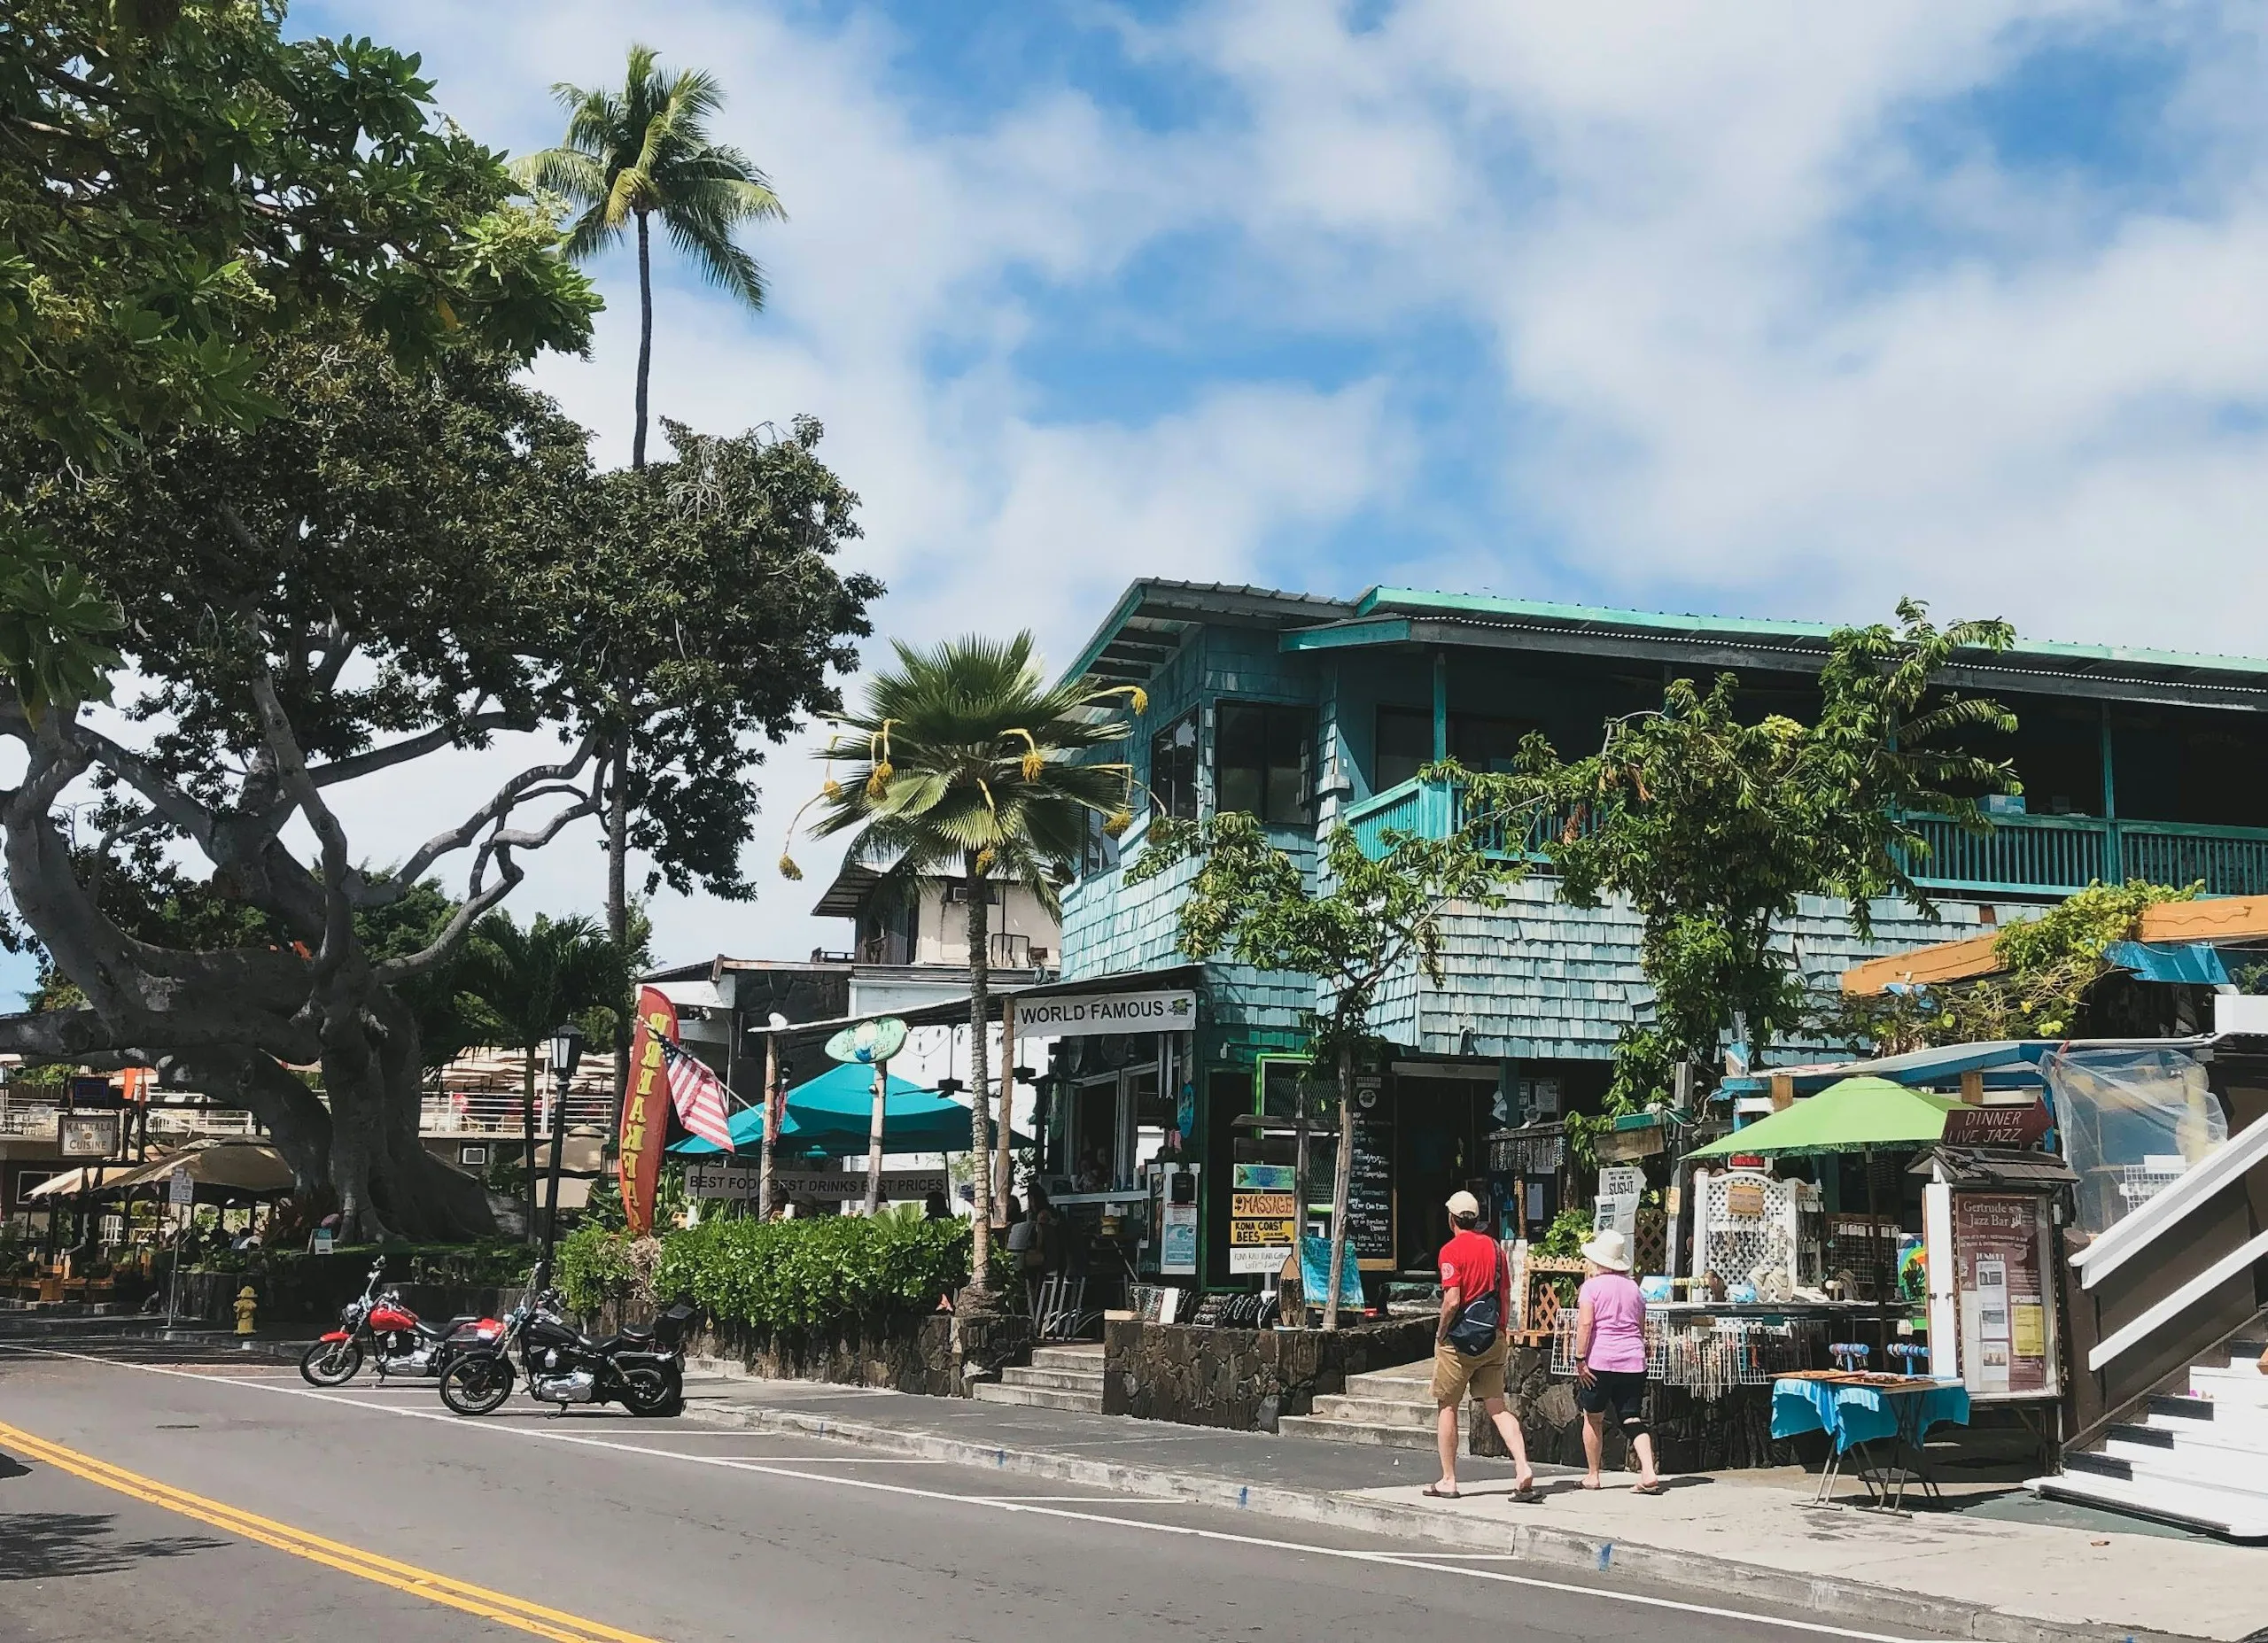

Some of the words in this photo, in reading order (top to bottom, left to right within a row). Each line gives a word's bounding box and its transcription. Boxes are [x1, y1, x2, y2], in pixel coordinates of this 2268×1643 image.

[1021, 1005, 1085, 1025] WORLD
[1091, 1000, 1164, 1020] FAMOUS
[1965, 1111, 2022, 1127] DINNER
[1947, 1129, 1979, 1143] LIVE
[1983, 1128, 2023, 1143] JAZZ
[69, 1140, 107, 1151] CUISINE
[689, 1175, 724, 1189] BEST
[808, 1179, 858, 1193] DRINKS
[897, 1178, 944, 1192] PRICES
[1608, 1181, 1635, 1196] SUSHI
[1242, 1195, 1293, 1214] MASSAGE
[1963, 1200, 2015, 1213] Gertrude's
[1235, 1221, 1255, 1231] KONA
[1258, 1221, 1284, 1231] COAST
[1969, 1213, 1989, 1228] Jazz
[1992, 1214, 2008, 1227] Bar
[1236, 1231, 1261, 1243] BEES
